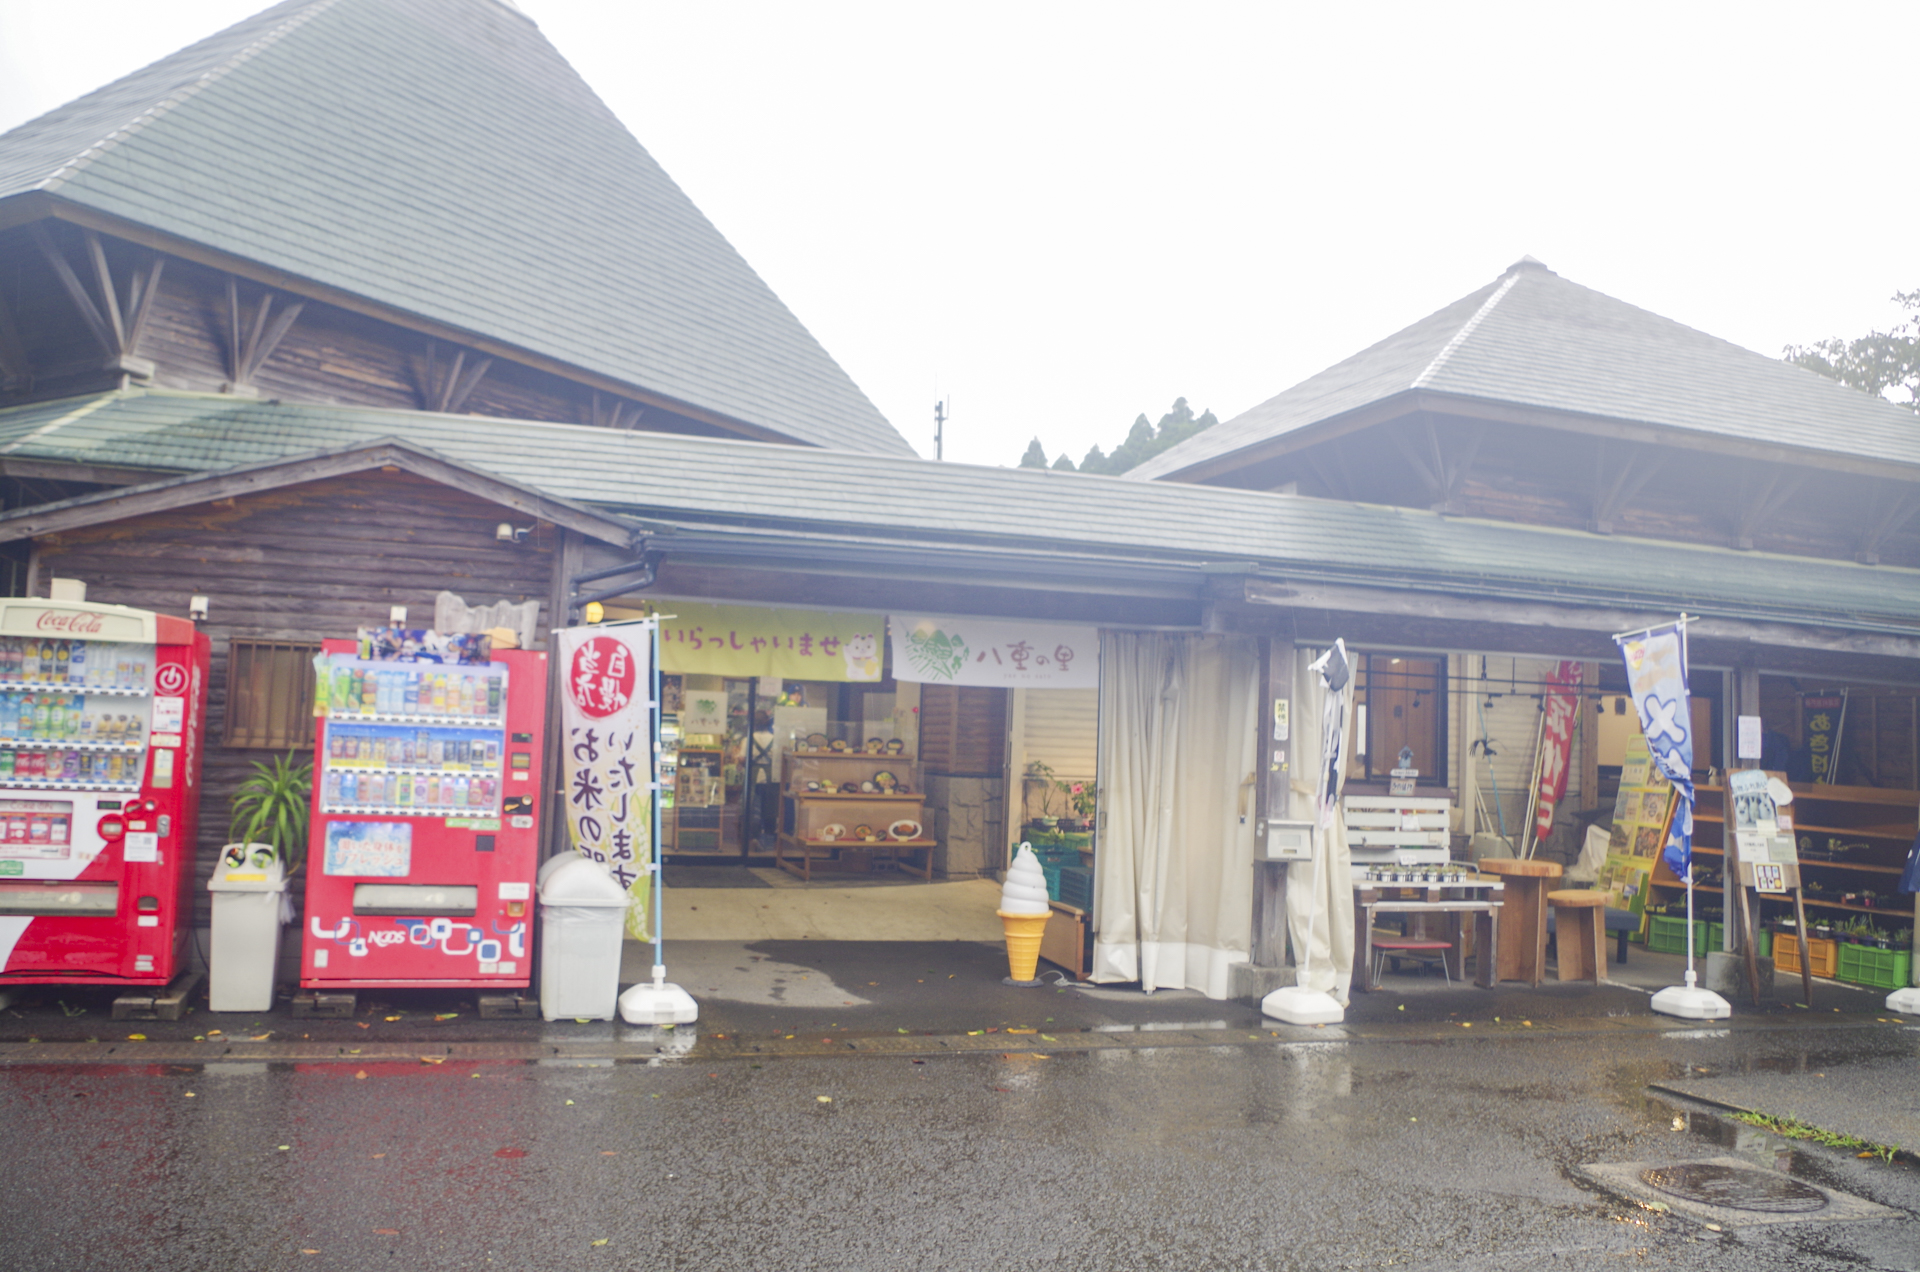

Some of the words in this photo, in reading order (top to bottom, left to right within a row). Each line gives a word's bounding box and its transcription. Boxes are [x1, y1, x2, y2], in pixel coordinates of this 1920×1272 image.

[664, 626, 841, 656] いらっしゃいませ
[976, 640, 1074, 671] 八重の里
[335, 851, 403, 865] リフレッシュ
